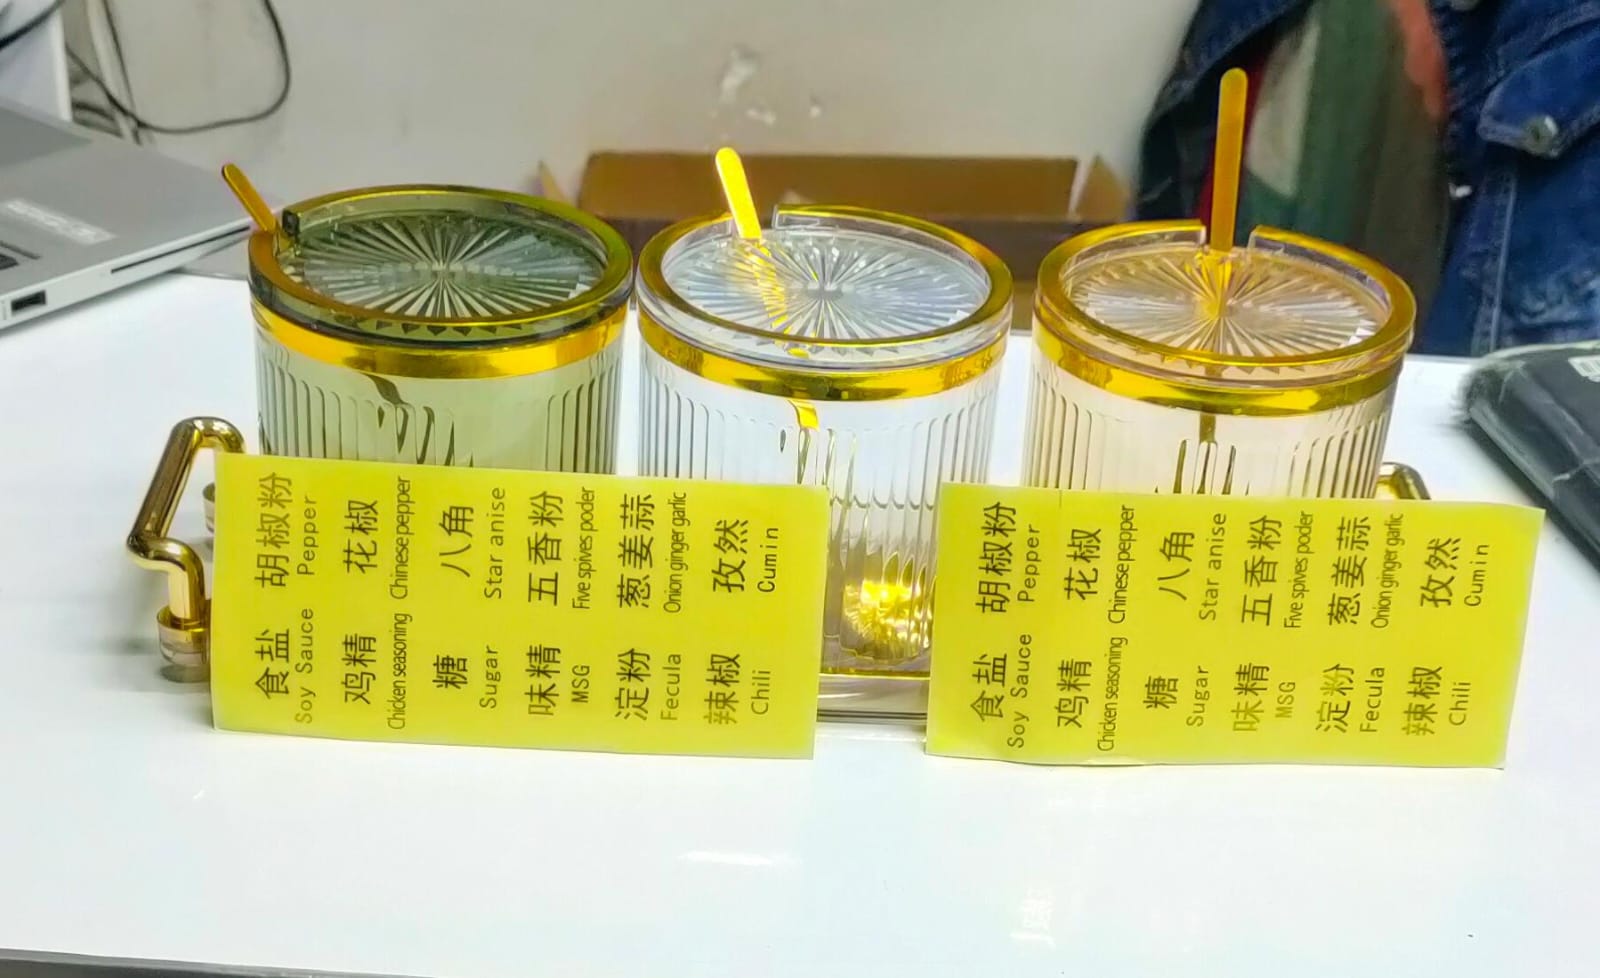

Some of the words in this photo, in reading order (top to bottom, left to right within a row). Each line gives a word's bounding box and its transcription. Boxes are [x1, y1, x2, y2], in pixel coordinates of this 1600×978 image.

[254, 472, 293, 588] 胡椒粉
[296, 496, 320, 575] Pepper
[342, 500, 378, 574] 花椒
[438, 504, 474, 578] 八角
[486, 487, 506, 546] anise
[575, 486, 598, 532] poder
[668, 492, 690, 527] garlic
[1205, 512, 1227, 571] anise
[1384, 513, 1406, 547] garlic
[484, 557, 503, 599] Star
[527, 490, 564, 606] 五香粉
[616, 494, 654, 608] 葱姜蒜
[666, 528, 688, 570] ginger
[712, 519, 748, 594] 孜然
[757, 527, 779, 593] Cumin
[975, 502, 1016, 614] 胡椒粉
[1018, 524, 1042, 602] Pepper
[1064, 528, 1102, 600] 花椒
[1156, 531, 1195, 601] 八角
[1241, 514, 1282, 626] 五香粉
[1284, 598, 1304, 628] Five
[1294, 510, 1316, 554] poder
[1328, 516, 1372, 626] 葱姜蒜
[1377, 547, 1402, 589] ginger
[1420, 537, 1461, 608] 孜然
[1464, 544, 1490, 607] Cumin
[572, 580, 590, 610] Five
[663, 574, 681, 614] Onion
[1198, 578, 1220, 620] Star
[1370, 588, 1392, 628] Onion
[255, 629, 290, 699] 食盐
[295, 608, 314, 673] Sauce
[340, 633, 376, 704] 鸡精
[389, 612, 412, 678] seasoning
[432, 654, 468, 690] 糖
[1010, 633, 1032, 698] Sauce
[1104, 636, 1128, 700] seasoning
[295, 687, 316, 724] Soy
[388, 680, 406, 730] Chicken
[479, 645, 500, 709] Sugar
[524, 644, 561, 716] 味精
[571, 664, 590, 703] MSG
[614, 648, 651, 720] 淀粉
[660, 653, 681, 720] Fecula
[704, 654, 740, 725] 辣椒
[751, 668, 771, 715] Chili
[970, 654, 1007, 722] 食盐
[1054, 658, 1092, 728] 鸡精
[1142, 676, 1179, 710] 糖
[1186, 665, 1210, 728] Sugar
[1230, 662, 1270, 732] 味精
[1275, 681, 1296, 718] MSG
[1316, 663, 1354, 734] 淀粉
[1360, 666, 1386, 732] Fecula
[1402, 666, 1443, 736] 辣椒
[1448, 682, 1471, 726] Chili
[1007, 711, 1029, 748] Soy
[1097, 698, 1118, 752] Chicken
